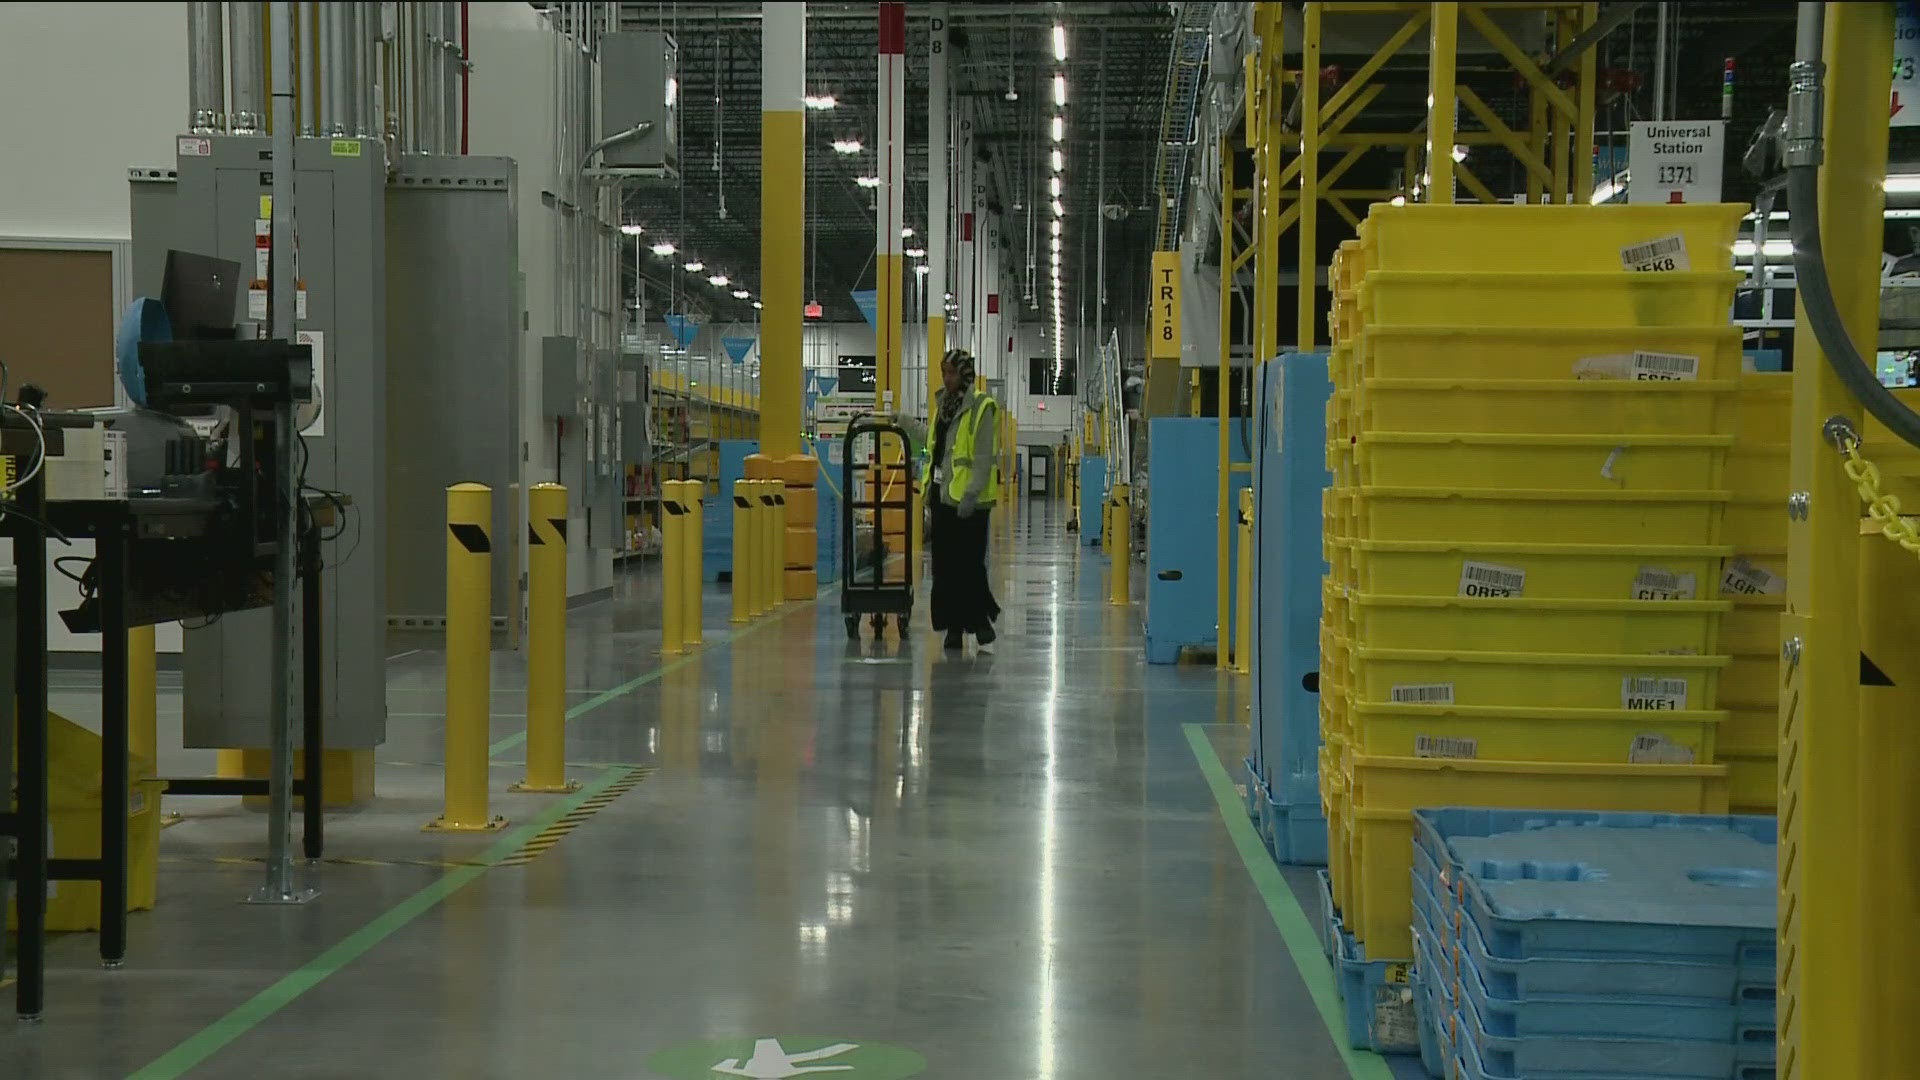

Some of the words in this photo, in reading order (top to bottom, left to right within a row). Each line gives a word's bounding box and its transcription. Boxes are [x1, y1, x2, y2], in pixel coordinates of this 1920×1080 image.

[1647, 125, 1711, 138] Universal
[1653, 141, 1703, 154] Station
[1658, 166, 1693, 184] 1371
